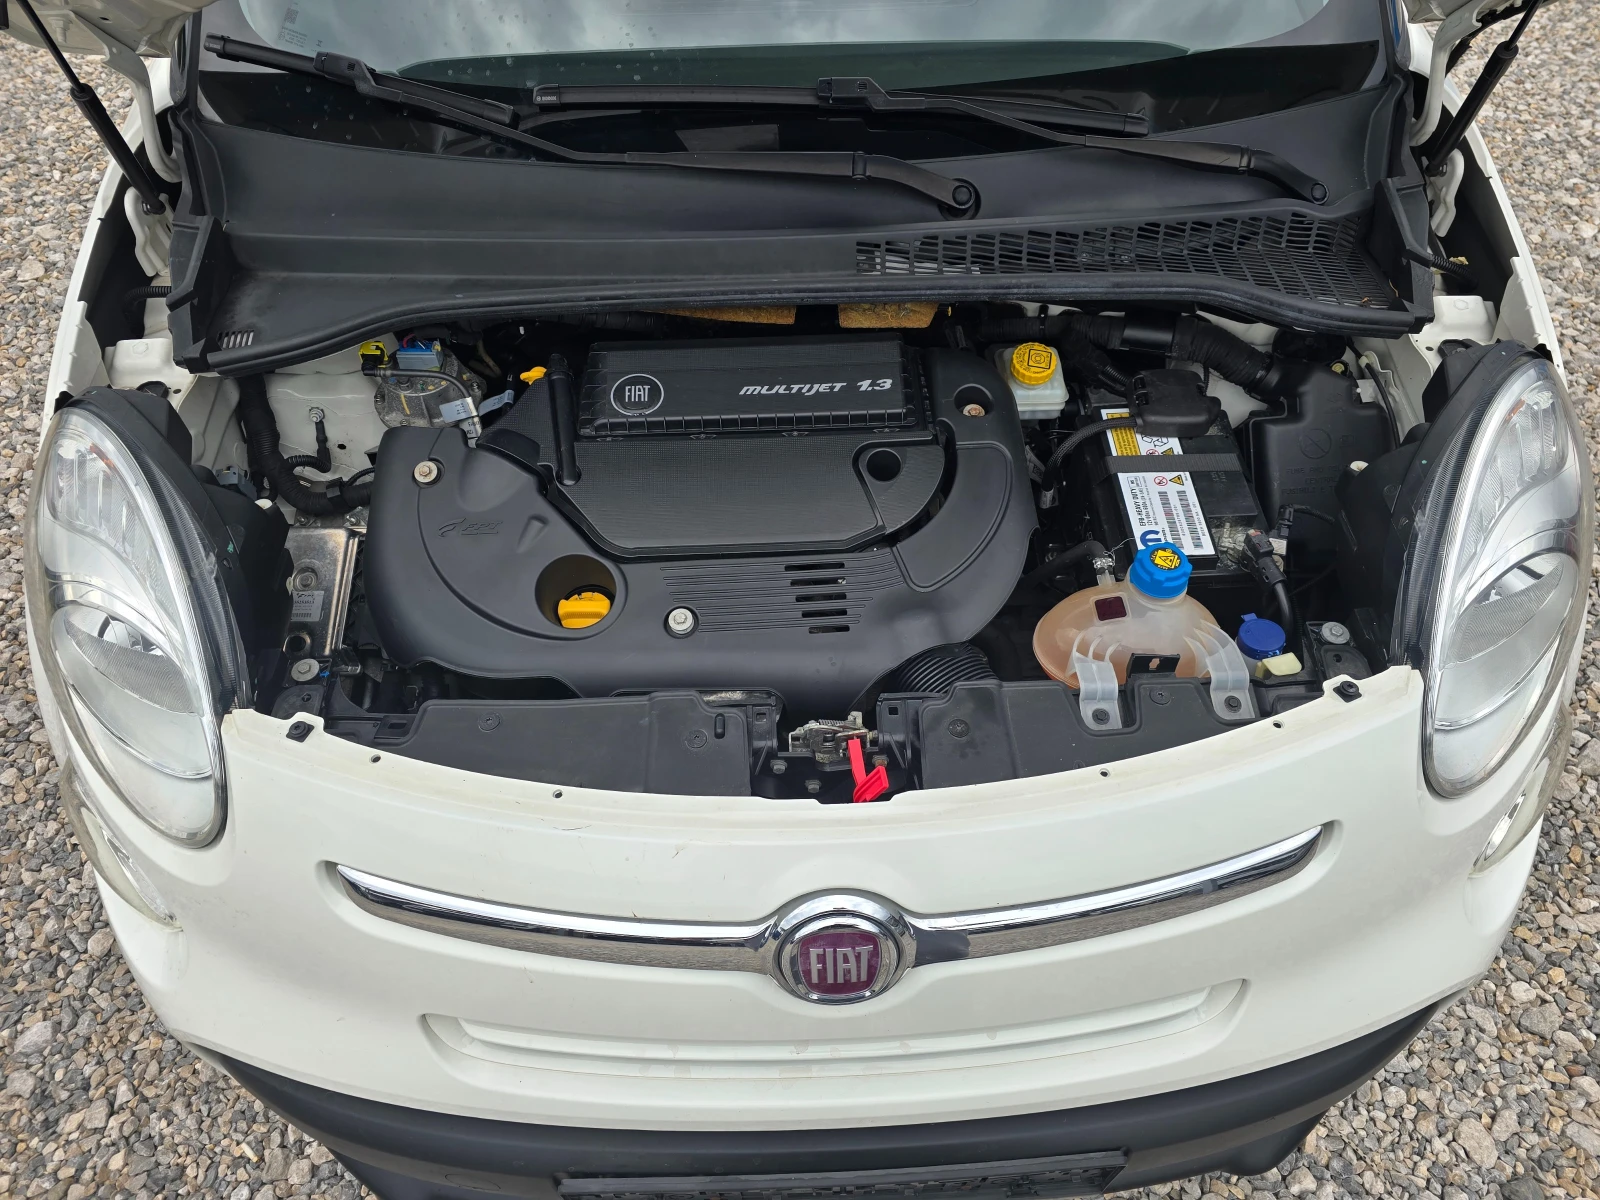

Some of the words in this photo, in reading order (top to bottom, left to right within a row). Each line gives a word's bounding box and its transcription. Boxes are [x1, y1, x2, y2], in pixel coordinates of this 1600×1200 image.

[625, 385, 651, 403] FIAT
[738, 382, 848, 396] MULTIJET
[856, 378, 893, 392] 1.3
[809, 945, 873, 984] FIAT
